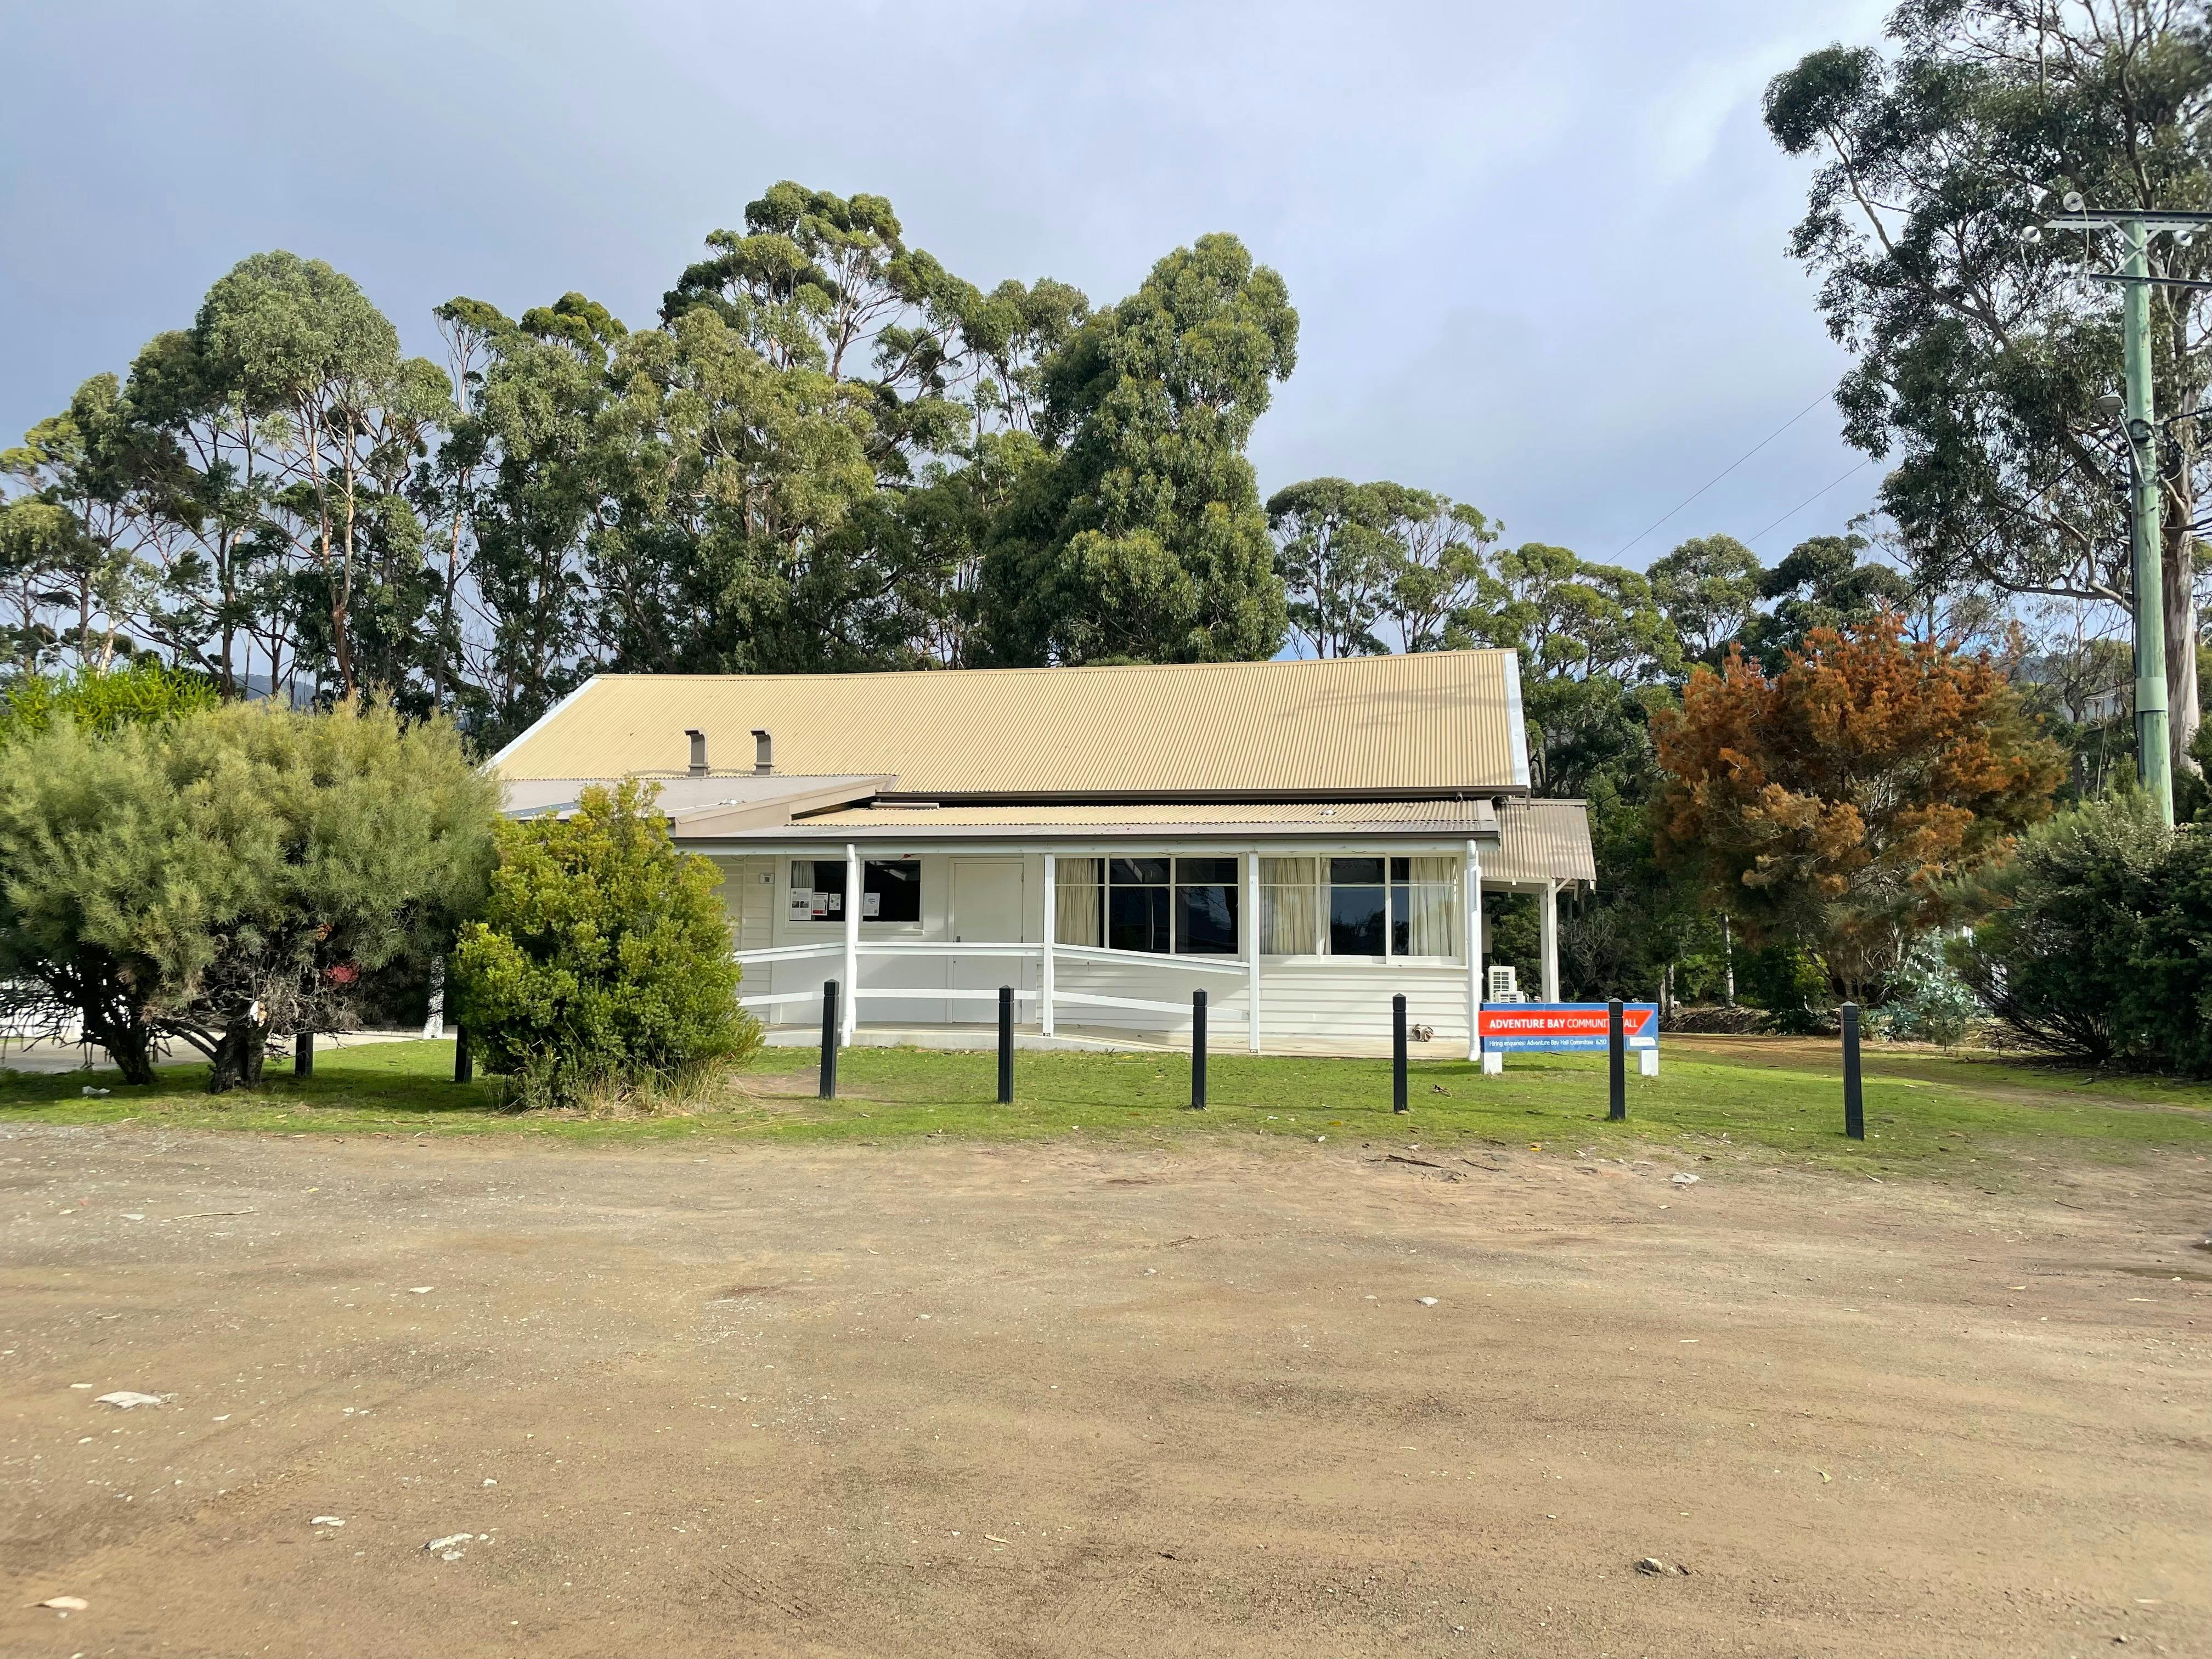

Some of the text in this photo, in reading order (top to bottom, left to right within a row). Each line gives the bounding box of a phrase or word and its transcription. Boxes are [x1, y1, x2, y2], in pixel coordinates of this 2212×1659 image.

[1489, 1018, 1638, 1028] ADVENTURE BAY COMMUNI ALL
